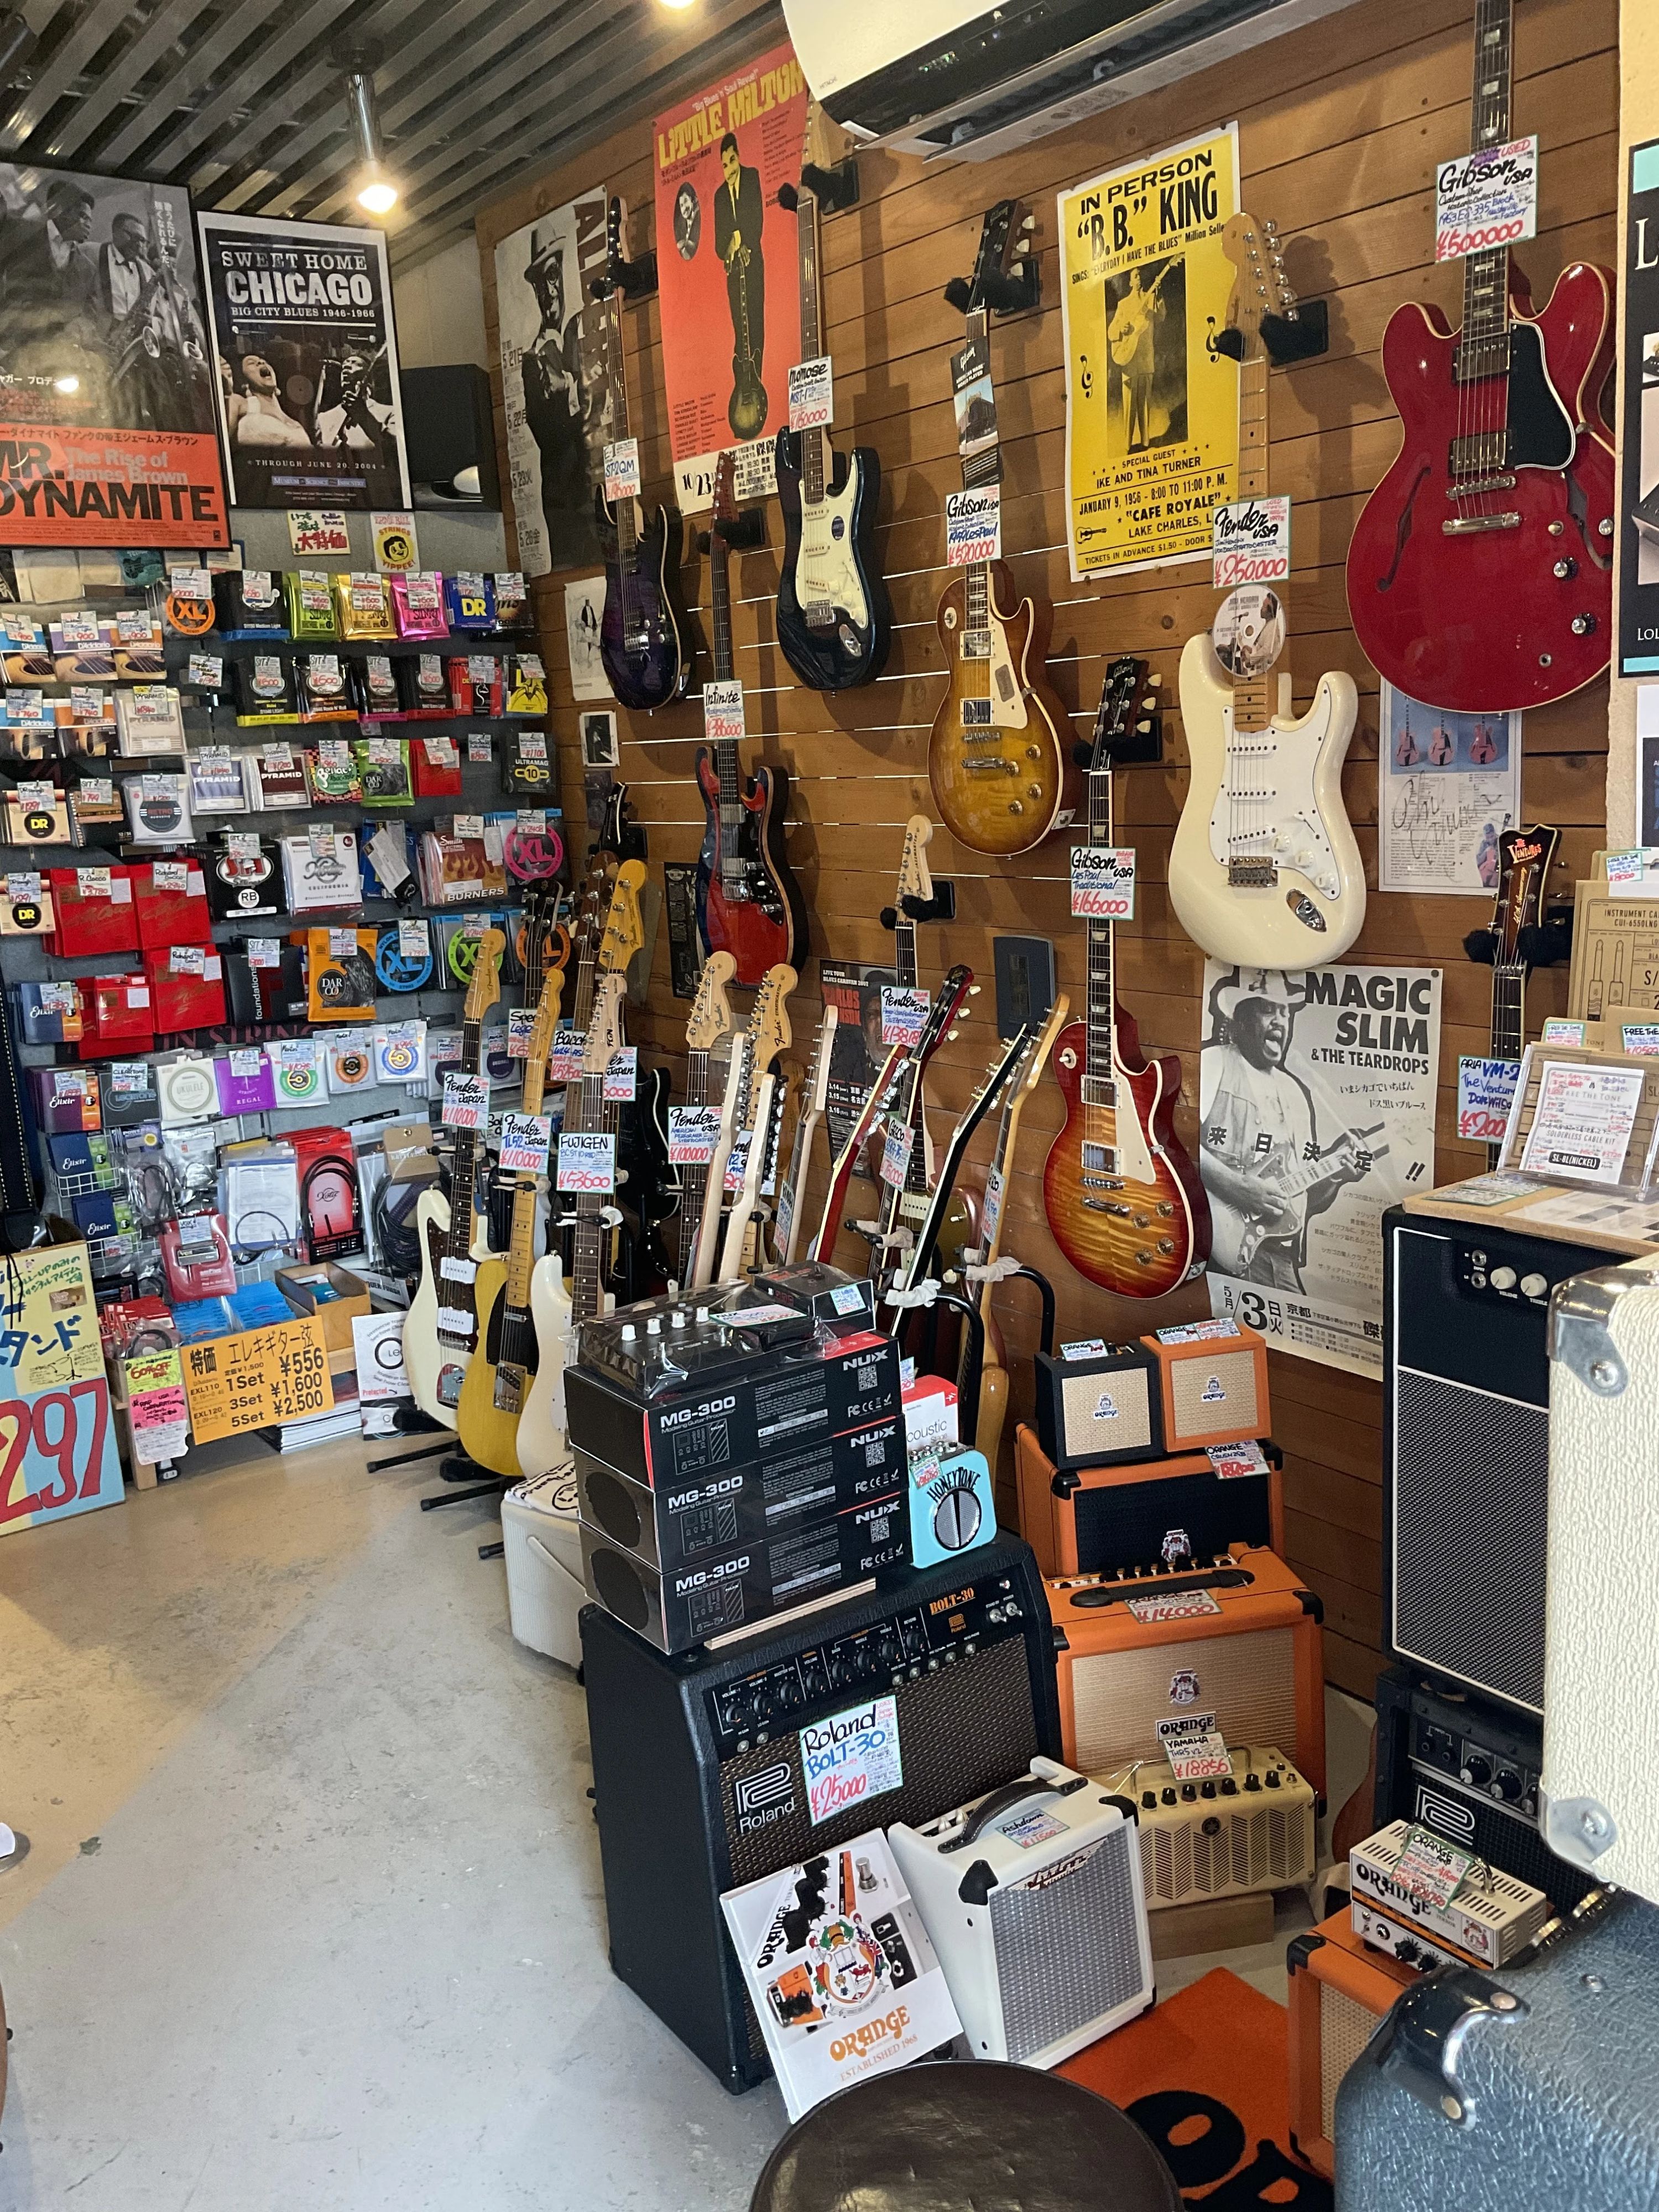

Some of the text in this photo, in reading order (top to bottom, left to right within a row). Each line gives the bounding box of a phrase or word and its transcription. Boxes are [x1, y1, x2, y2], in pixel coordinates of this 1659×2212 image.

[1500, 139, 1531, 158] USED
[1081, 149, 1213, 216] IN PERSON
[1438, 158, 1517, 194] Gibson
[1504, 168, 1533, 186] USA
[1160, 170, 1218, 236] KING
[1127, 228, 1207, 263] HAVE THE Million
[221, 251, 367, 271] SWEET HOME
[226, 270, 373, 306] CHICAGO
[231, 306, 375, 318] BIG CITY BLUES 1946-1966
[960, 346, 976, 372] Gibson
[65, 447, 169, 468] The Rise of
[255, 459, 302, 467] THROUGH
[1122, 449, 1176, 469] SPECIAL GUEST
[67, 465, 188, 484] James Brown
[1097, 456, 1201, 489] IKE AND TINA TURNER
[947, 493, 987, 519] Gibson
[1079, 478, 1204, 516] JANUARY 1956 8:00 TO 11:00
[1129, 517, 1202, 539] LAKE CHARLES,
[1214, 501, 1269, 538] Fender
[297, 529, 348, 552] 大特価
[378, 527, 411, 536] STRINGS
[1253, 522, 1279, 539] USA
[1086, 536, 1204, 565] TICKETS IN ADVANCE $1.50 DOOR
[382, 559, 416, 571] YIPPEE!
[176, 600, 207, 620] XL
[462, 598, 487, 617] DR
[135, 692, 165, 700] PYRAMID
[705, 685, 740, 707] Infinite
[265, 748, 289, 757] PYRAMID
[193, 775, 241, 784] PYRAMID
[261, 771, 302, 780] PYRAMID
[366, 775, 382, 784] DAR
[526, 769, 538, 778] 10
[30, 818, 48, 830] DR
[440, 835, 463, 846] Smith
[515, 839, 555, 864] XL
[1072, 848, 1117, 870] Gibson
[1072, 869, 1102, 880] Les Paul
[1113, 867, 1134, 878] USA
[1073, 879, 1119, 890] Traditional
[241, 892, 258, 901] RB
[447, 888, 504, 902] BURNERS
[18, 909, 35, 920] DR
[1604, 909, 1646, 919] INSTRUMENT
[385, 949, 423, 974] XL
[321, 978, 342, 987] DAR
[324, 986, 339, 996] CO
[252, 966, 263, 1020] foundations
[774, 983, 782, 1017] STRATOCASTER
[884, 988, 918, 1008] Fender
[1305, 971, 1432, 1015] MAGIC
[30, 1005, 55, 1019] Elixir
[914, 1004, 929, 1013] USA
[774, 1018, 786, 1047] Fender
[1335, 1011, 1430, 1055] SLIM
[1624, 1027, 1644, 1036] FREE
[607, 1066, 635, 1078] Japan
[1311, 1048, 1430, 1076] & THE TEARDROPS
[1460, 1058, 1481, 1069] ARIA
[176, 1082, 205, 1095] UKULELE
[445, 1074, 482, 1094] Fender
[828, 1082, 839, 1091] 3.14
[1340, 1082, 1415, 1093] いまシカゴでいちばん
[1461, 1072, 1480, 1088] The
[49, 1095, 75, 1108] Elixir
[236, 1095, 262, 1105] REGAL
[458, 1093, 486, 1105] Japan
[828, 1092, 839, 1100] 3.15
[1600, 1093, 1621, 1102] TONE
[505, 1114, 542, 1135] Fender
[670, 1106, 721, 1127] Fender
[503, 1134, 548, 1149] TL52 Japan
[561, 1134, 608, 1150] FUJIGEN
[1546, 1129, 1616, 1146] SOLDERLESS CABLE KIT
[62, 1157, 87, 1171] Elixir
[87, 1222, 112, 1235] Elixir
[1241, 1291, 1268, 1331] 3
[1285, 1303, 1312, 1318] 京都
[1159, 1326, 1188, 1336] ORANGE
[228, 1323, 315, 1364] エレキギター弦
[1063, 1342, 1092, 1352] ORANGE
[190, 1346, 218, 1377] 特価
[279, 1347, 324, 1377] ¥556
[843, 1349, 889, 1371] NUX
[190, 1383, 220, 1396] EXL110
[270, 1371, 322, 1398] ¥1,600
[363, 1387, 388, 1396] Protected
[194, 1406, 222, 1420] EXL120
[273, 1389, 324, 1417] ¥2,500
[660, 1396, 736, 1429] MG-300
[850, 1425, 896, 1448] NUX
[1207, 1443, 1244, 1455] ORANGE
[667, 1475, 744, 1509] MG-300
[926, 1466, 981, 1503] HONEYTONE
[855, 1501, 901, 1525] NUX
[675, 1555, 750, 1593] MG-300
[929, 1587, 975, 1616] BOLT-30
[877, 1699, 893, 1709] USED
[802, 1703, 877, 1756] Roland
[1160, 1715, 1214, 1736] ORANGE
[1166, 1734, 1209, 1749] YAMAHA
[804, 1729, 886, 1780] BOLT-30
[739, 1797, 795, 1834] Roland
[1001, 1812, 1045, 1835] Ashdown
[1413, 1834, 1454, 1860] ORANGE
[1355, 1863, 1431, 1917] ORANGE
[757, 1903, 791, 1969] ORANGE
[830, 2005, 911, 2062] ORANGE
[840, 2033, 919, 2083] ESTABLISHED 1968
